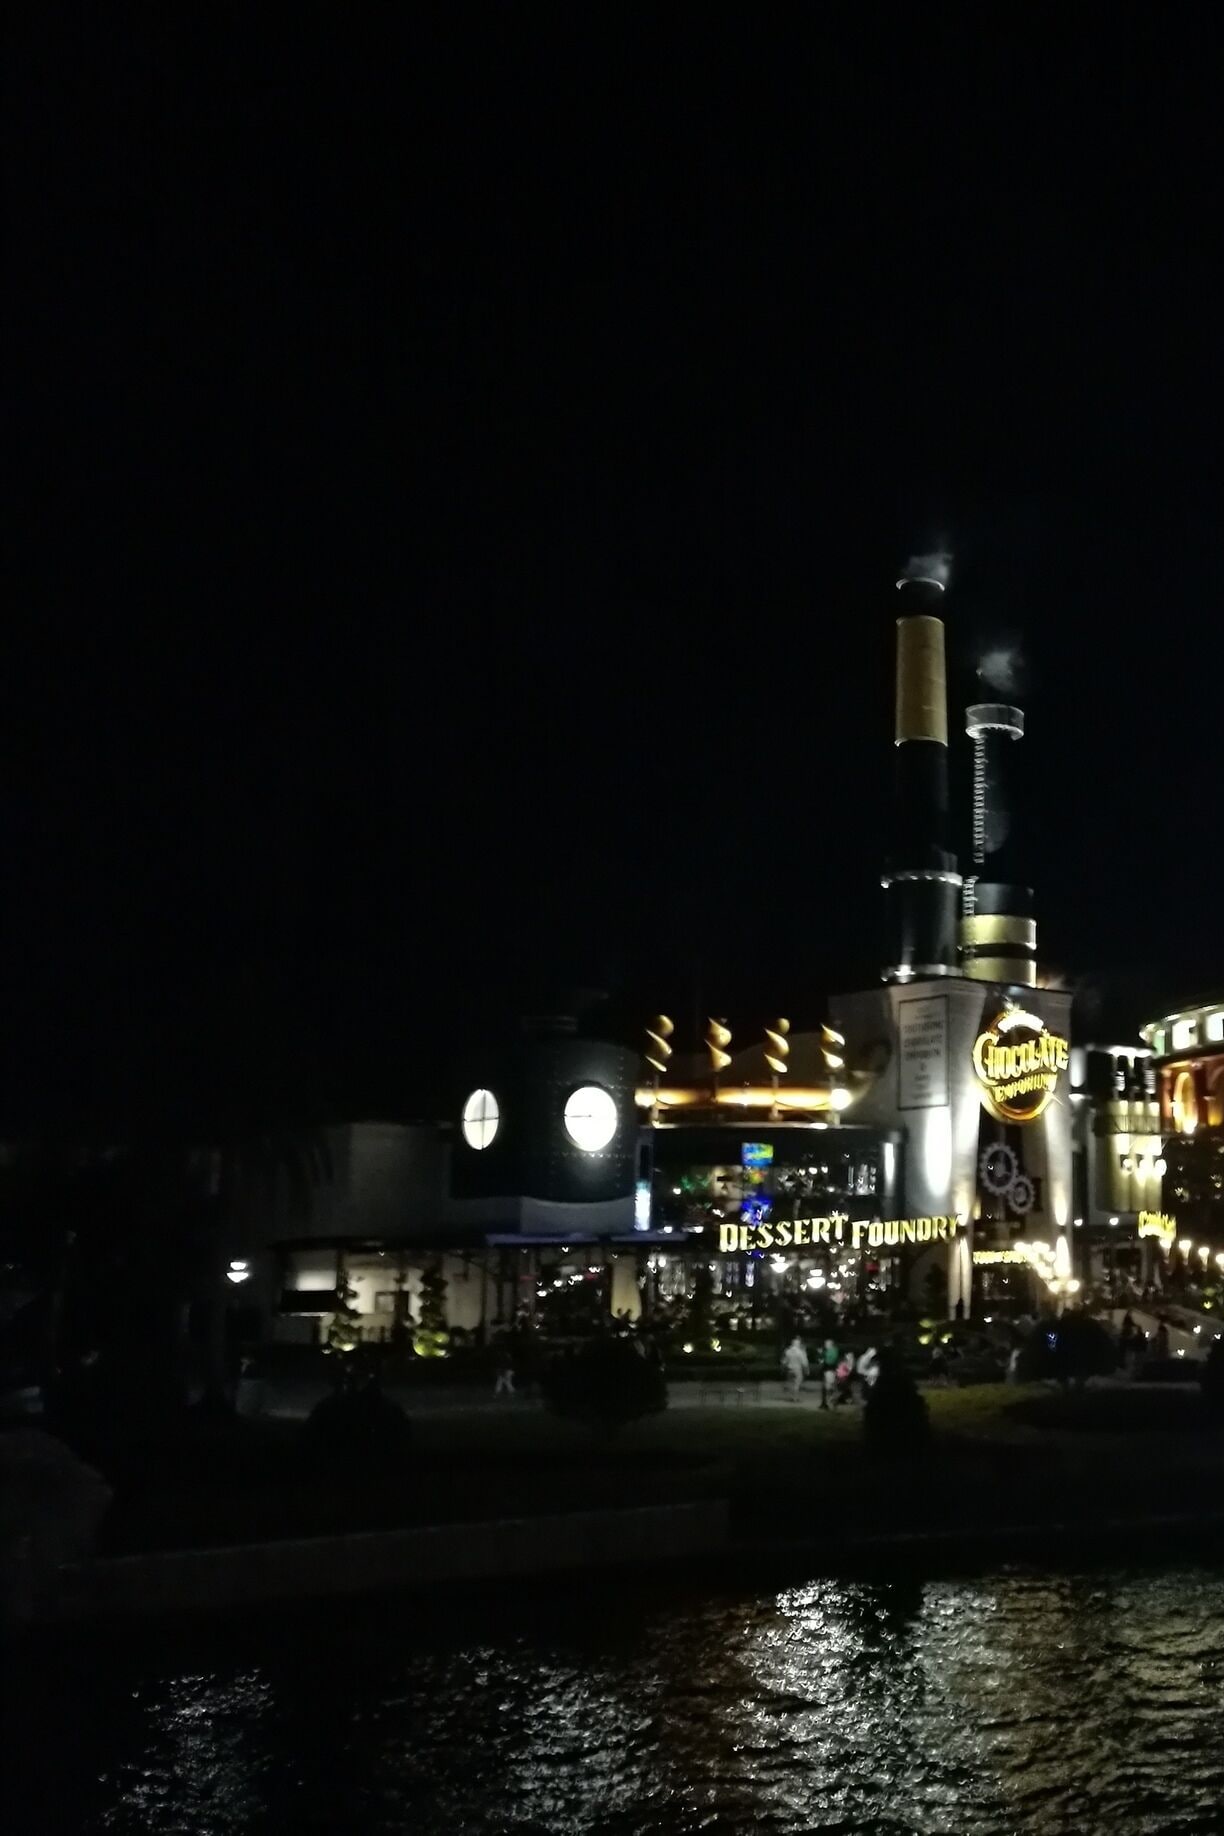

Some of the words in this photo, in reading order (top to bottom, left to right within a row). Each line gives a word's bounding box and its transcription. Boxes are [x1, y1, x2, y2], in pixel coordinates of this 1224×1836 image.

[973, 1031, 1069, 1086] CHOCOLATE
[719, 1211, 848, 1253] DESSERT
[851, 1216, 960, 1250] FOUNDRY
